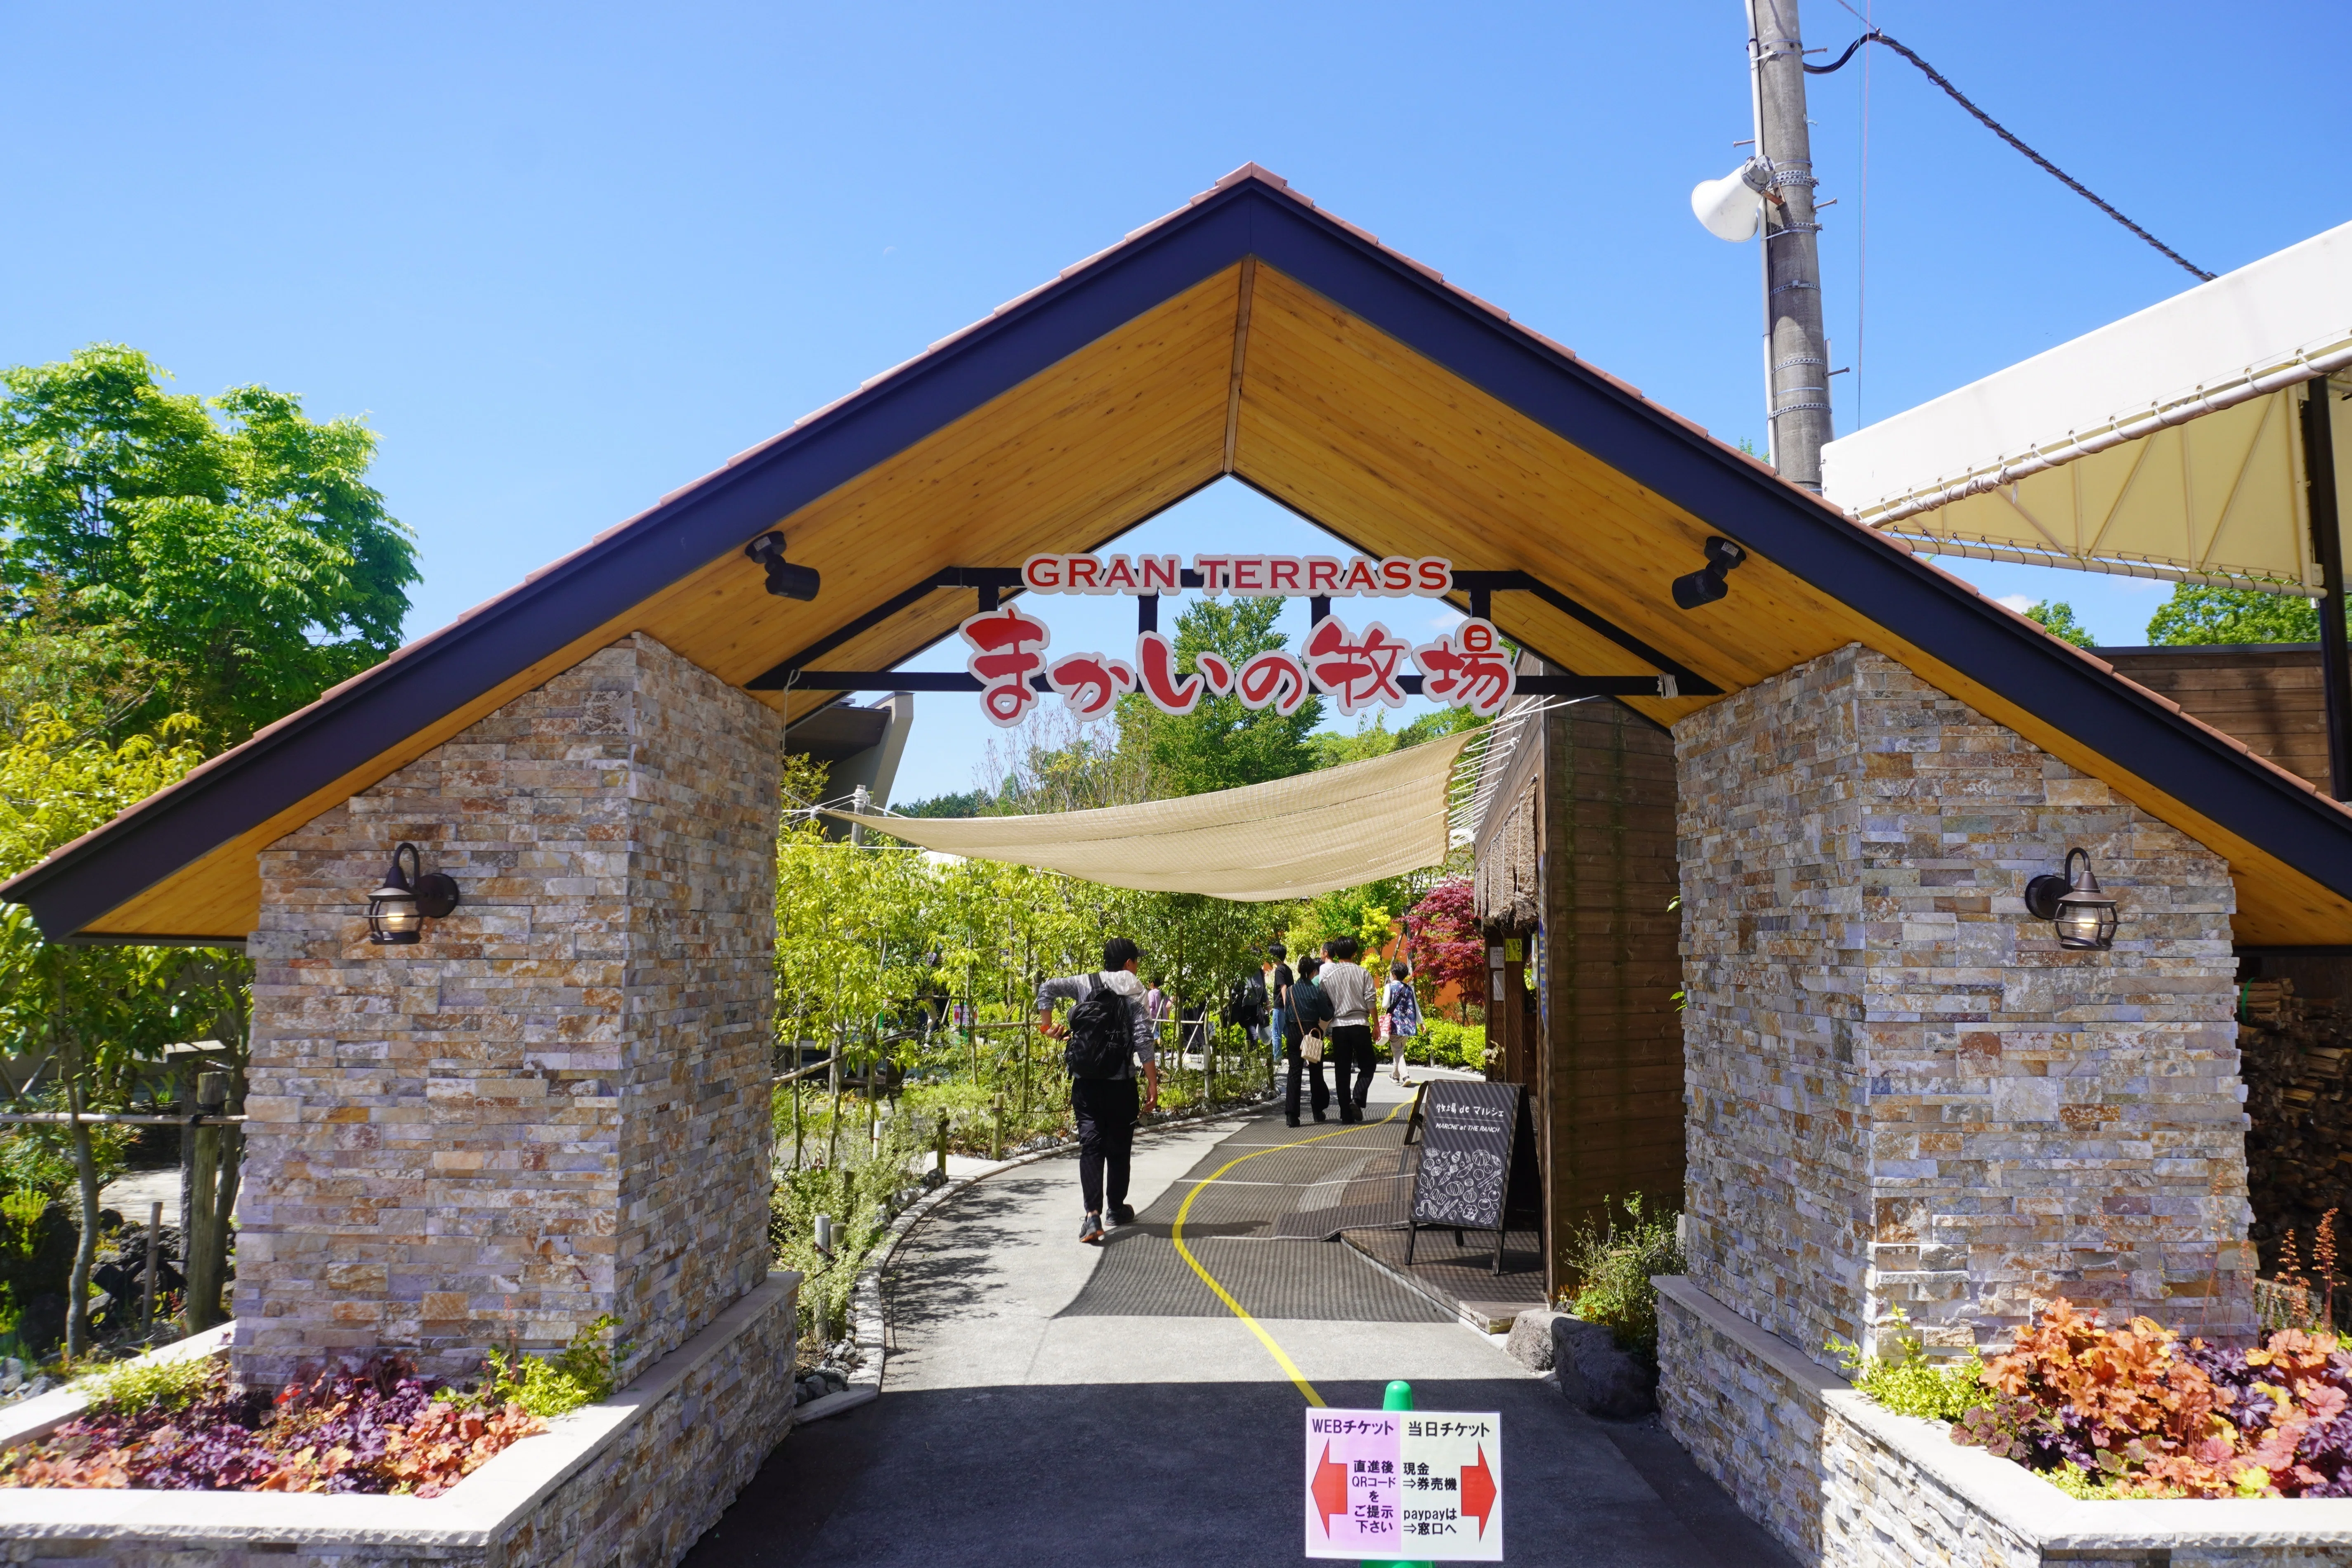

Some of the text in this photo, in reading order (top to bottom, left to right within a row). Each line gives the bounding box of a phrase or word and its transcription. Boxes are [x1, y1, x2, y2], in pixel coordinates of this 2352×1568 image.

[1027, 558, 1448, 590] GRAN TERRASS
[966, 608, 1509, 720] まかいの牧場
[1436, 1103, 1504, 1117] 牧場 de マルシェ
[1312, 1419, 1394, 1435] WEBチケット
[1408, 1421, 1490, 1437] 当日チケット
[1353, 1459, 1394, 1474] 直進後
[1403, 1462, 1429, 1475] 現金
[1352, 1476, 1396, 1488] QRコード
[1417, 1477, 1457, 1491] 券売機
[1369, 1490, 1379, 1503] を
[1354, 1504, 1393, 1519] ご提示
[1404, 1508, 1457, 1521] paypayは
[1355, 1520, 1393, 1533] 下さい
[1418, 1522, 1457, 1535] 窓口へ
